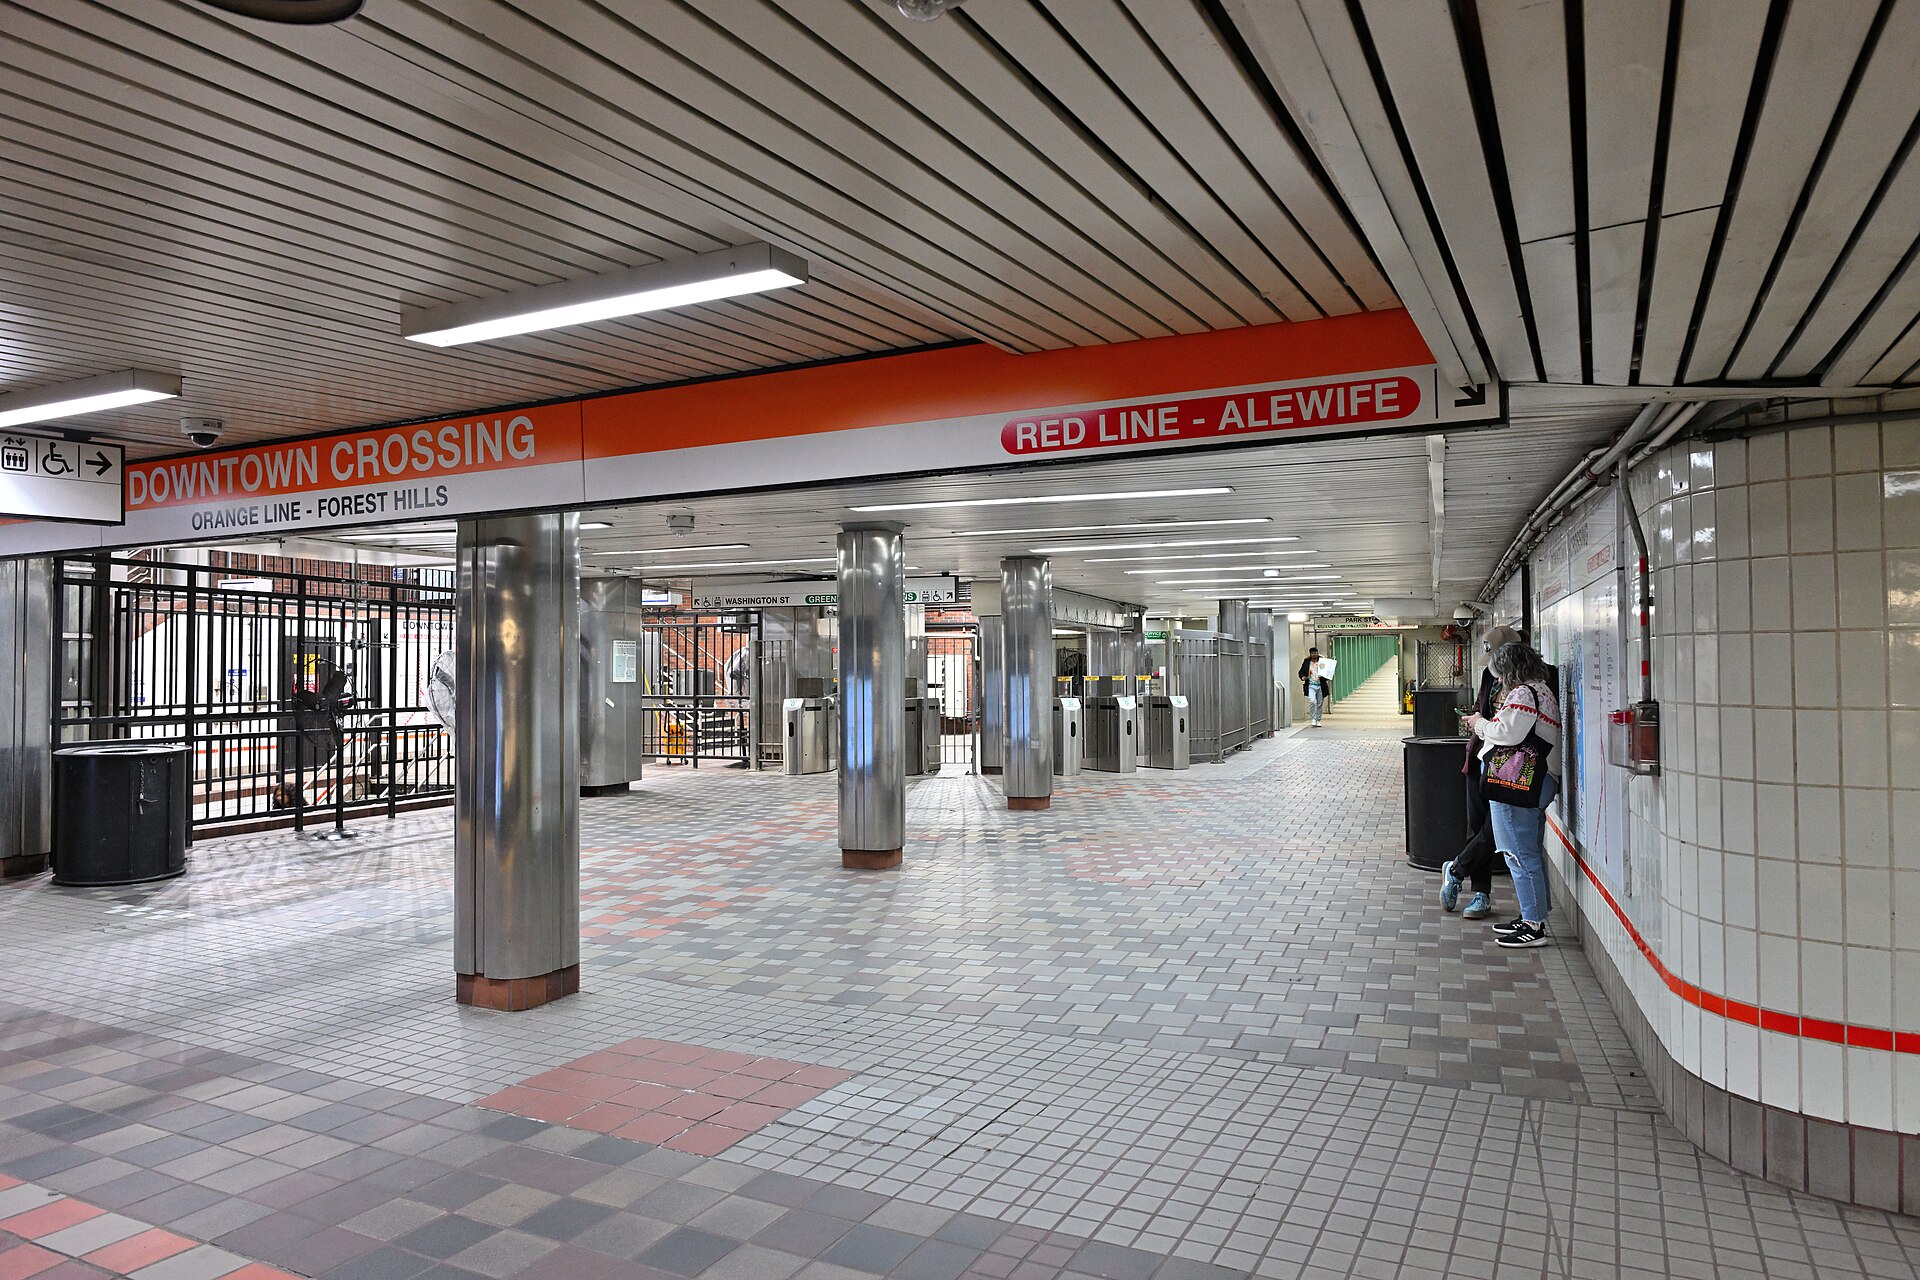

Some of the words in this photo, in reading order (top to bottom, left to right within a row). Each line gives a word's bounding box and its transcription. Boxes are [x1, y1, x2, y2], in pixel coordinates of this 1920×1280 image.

[1016, 417, 1086, 450] RED
[1099, 406, 1179, 442] LINE
[1218, 380, 1399, 431] ALEWIFE
[129, 445, 318, 506] DOWNTOWN
[330, 415, 536, 482] CROSSING
[191, 505, 259, 531] ORANGE
[263, 500, 301, 525] LINE
[317, 491, 389, 519] FOREST
[393, 484, 449, 511] HILLS
[725, 596, 778, 605] WASHINGTON
[779, 596, 790, 604] ST
[808, 595, 838, 604] GREEN
